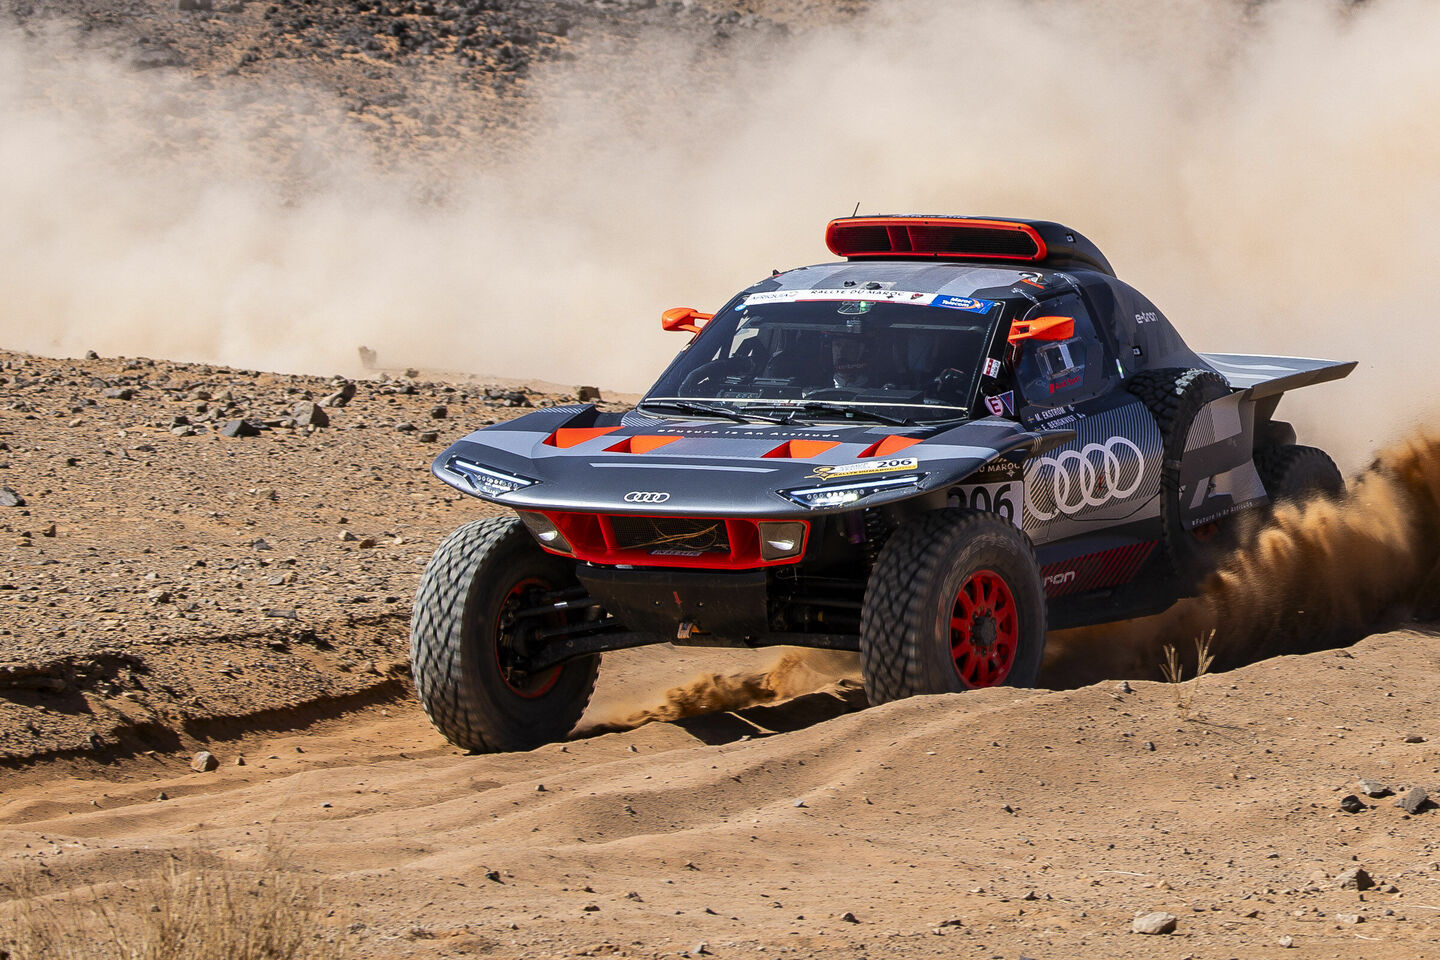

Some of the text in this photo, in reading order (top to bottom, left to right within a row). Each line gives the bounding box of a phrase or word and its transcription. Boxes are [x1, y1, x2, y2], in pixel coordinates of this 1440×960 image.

[1135, 311, 1159, 324] e-tron
[988, 397, 1002, 414] E
[877, 459, 912, 468] 206
[987, 462, 1021, 473] MAROC
[1043, 570, 1077, 588] ron
